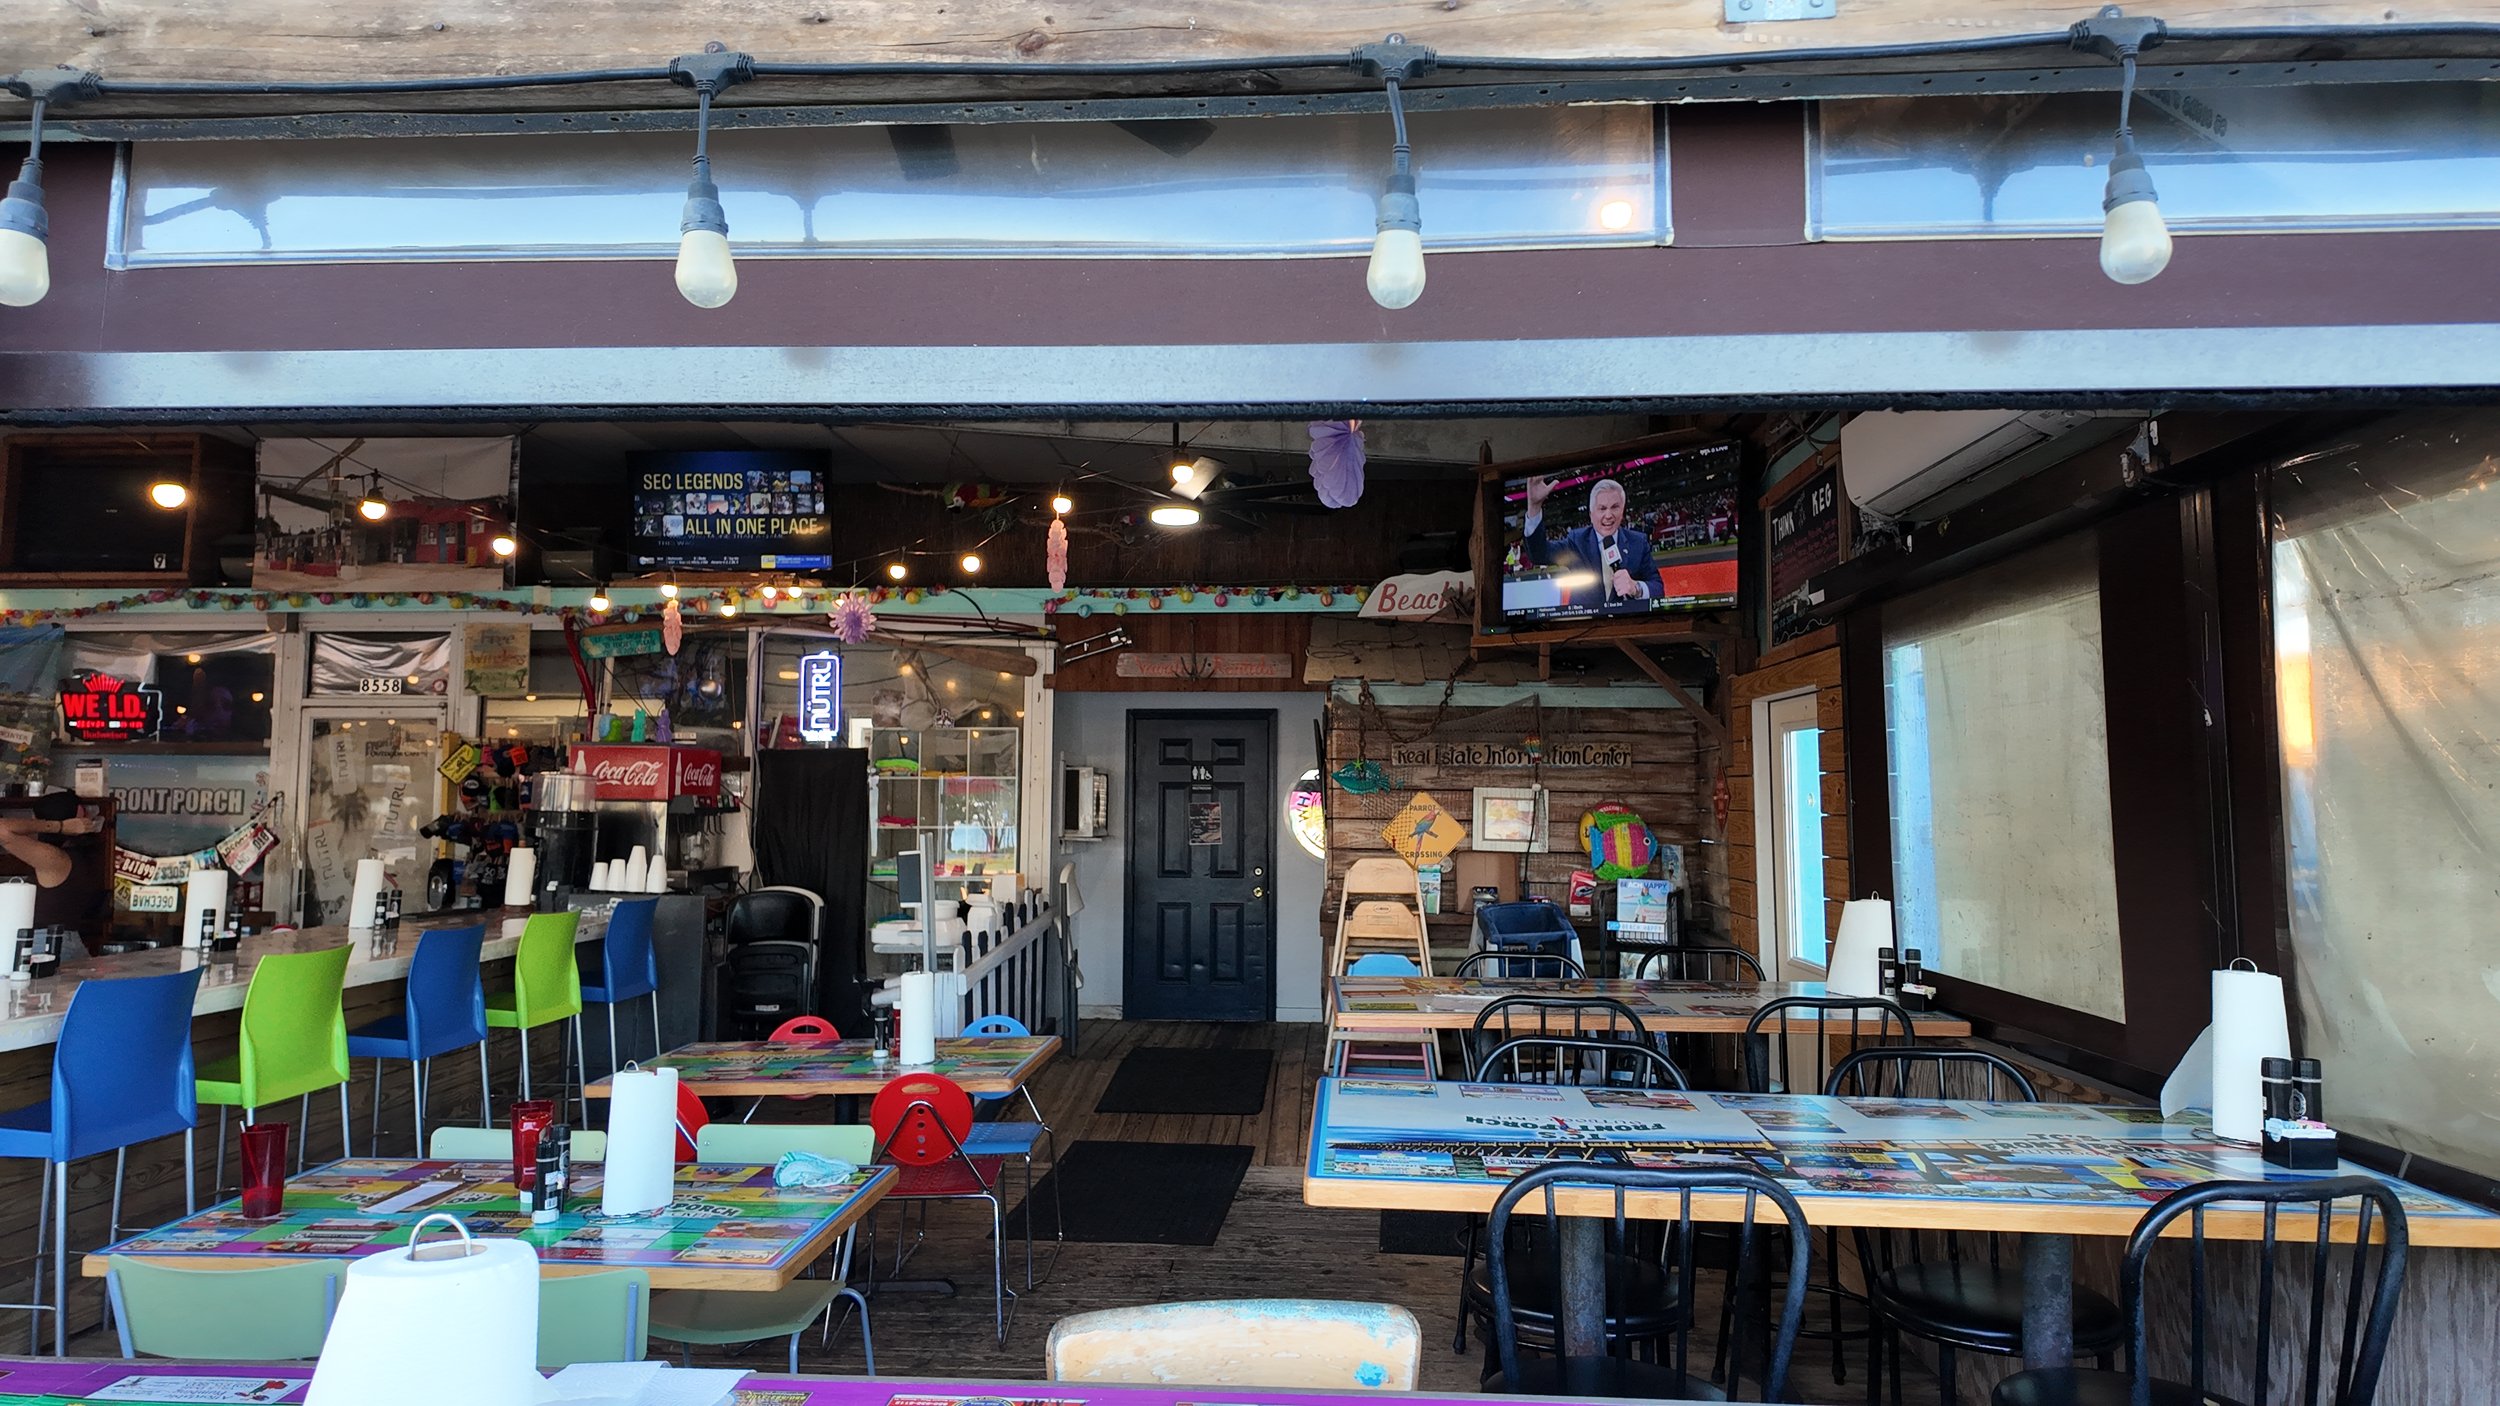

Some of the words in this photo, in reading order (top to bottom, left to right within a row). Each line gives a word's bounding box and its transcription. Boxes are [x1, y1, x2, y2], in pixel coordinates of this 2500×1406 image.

[643, 473, 672, 490] SEC
[676, 472, 743, 490] LEGENDS
[1811, 482, 1832, 517] KEG
[685, 518, 711, 535] ALL
[716, 518, 731, 535] IN
[735, 518, 769, 535] ONE
[770, 517, 818, 535] PLACE
[1772, 511, 1795, 546] THINK
[361, 679, 400, 693] 8558
[63, 694, 100, 718] WE
[108, 694, 147, 718] I.D.
[1397, 745, 1430, 765] Real
[1434, 744, 1482, 765] Estate
[1484, 743, 1581, 765] Infortion
[1582, 744, 1631, 765] Center
[592, 759, 664, 786] Coca-Cola
[171, 788, 244, 816] PORCH
[1409, 804, 1437, 812] PARROT
[1405, 850, 1443, 858] CROSSING
[1466, 1115, 1556, 1131] PORCH
[1576, 1122, 1667, 1132] FRONT
[673, 1203, 741, 1217] PORCH
